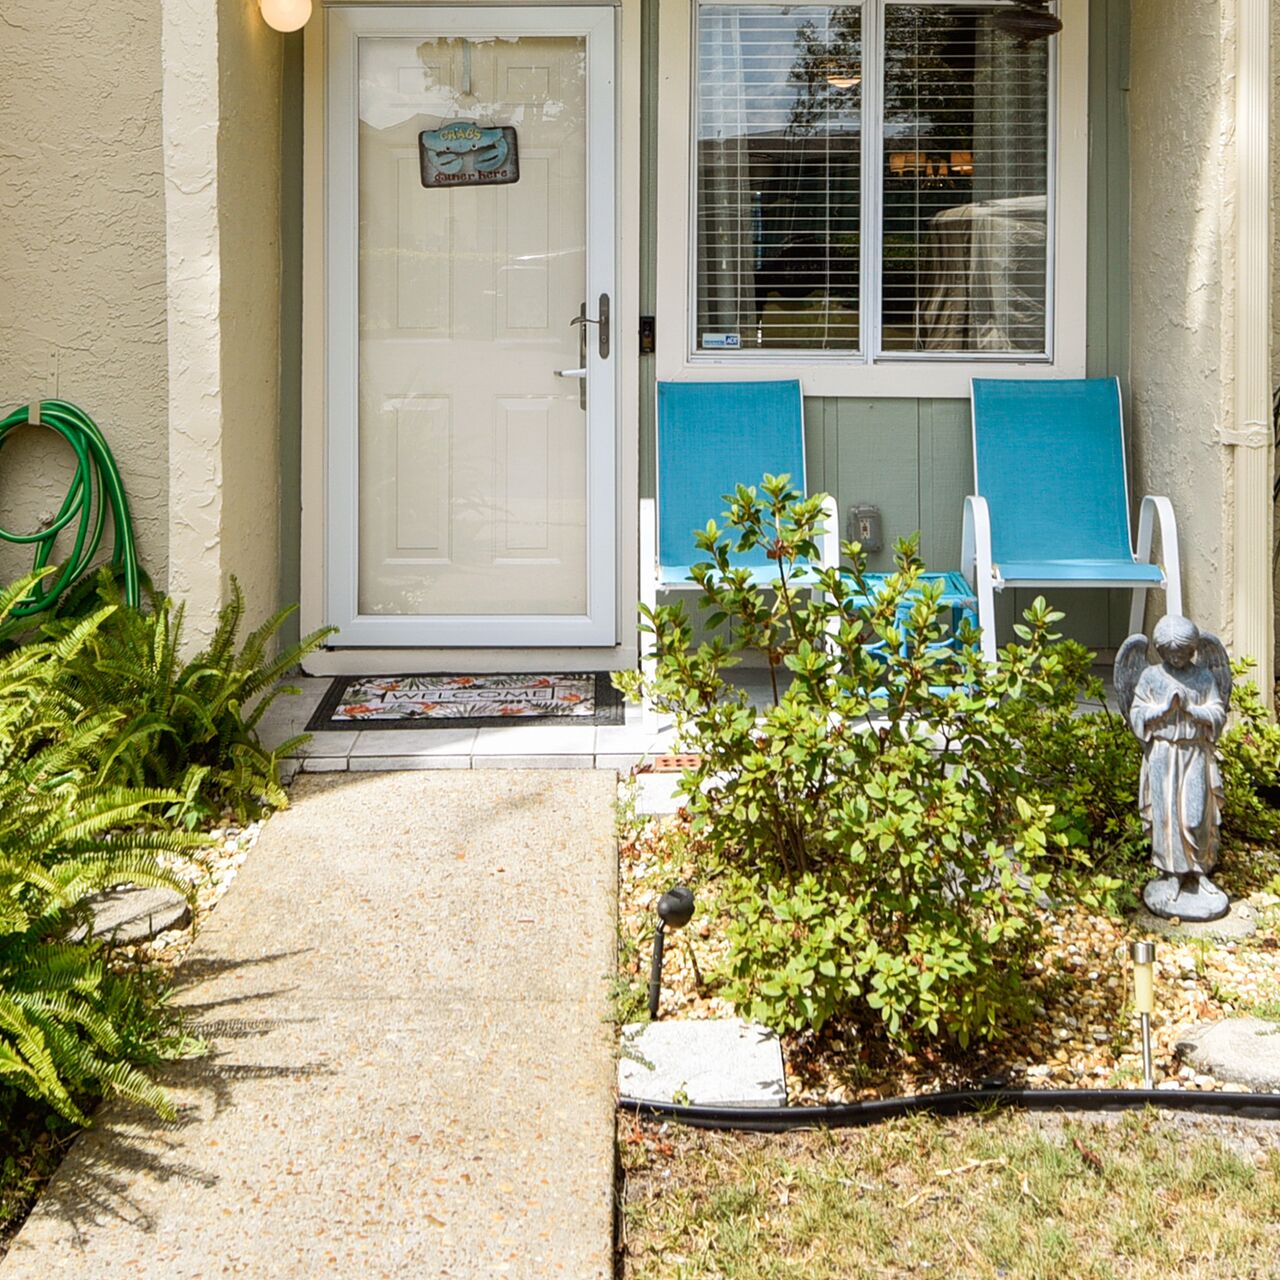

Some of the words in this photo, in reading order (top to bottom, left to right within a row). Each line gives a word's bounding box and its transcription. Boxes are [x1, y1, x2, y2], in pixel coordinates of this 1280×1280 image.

[440, 127, 481, 141] CRABS
[478, 169, 508, 181] here
[392, 689, 548, 701] WELCOME
